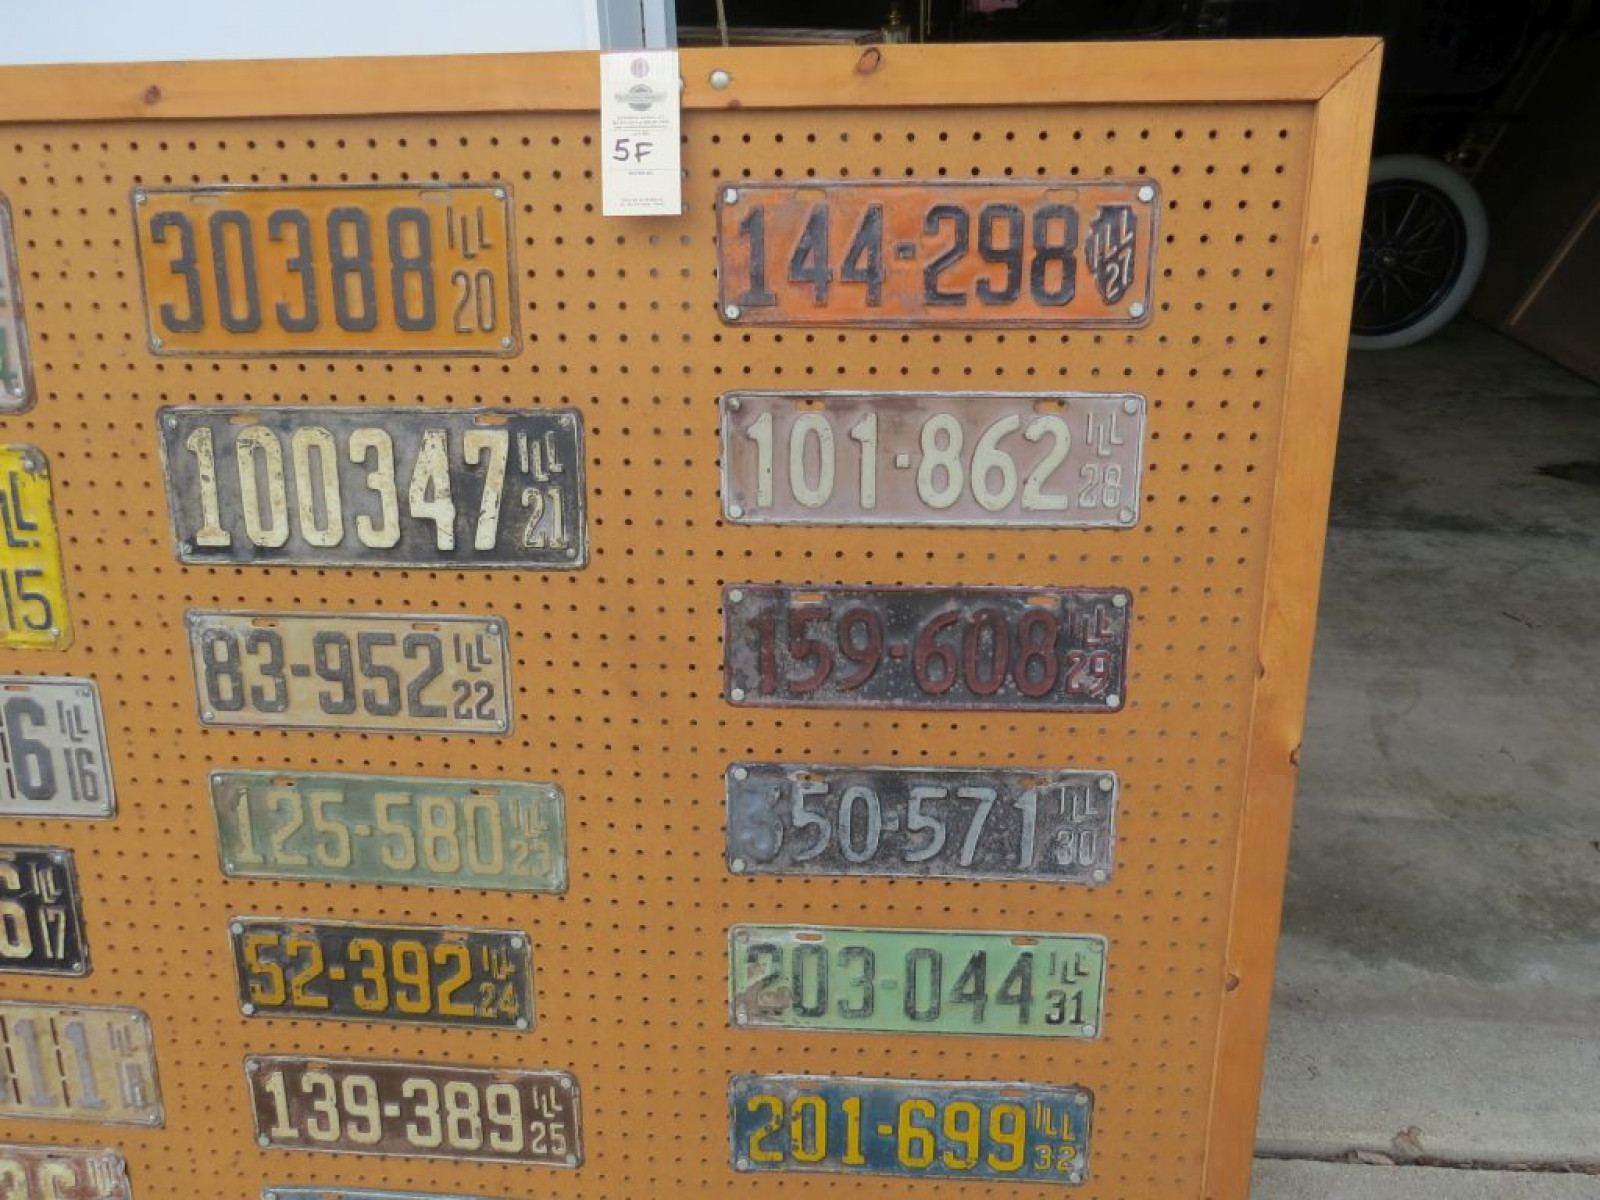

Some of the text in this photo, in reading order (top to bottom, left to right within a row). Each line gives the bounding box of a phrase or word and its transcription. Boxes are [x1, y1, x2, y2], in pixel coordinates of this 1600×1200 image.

[446, 205, 492, 259] ILL
[739, 204, 1078, 306] 144-298
[1094, 208, 1134, 270] ILL
[150, 207, 436, 333] 30388
[1106, 246, 1132, 299] 27
[451, 269, 496, 333] 20
[517, 431, 564, 482] ILL
[1086, 412, 1123, 456] ILL
[746, 411, 1071, 512] 101-862
[1078, 463, 1122, 508] 28
[0, 472, 39, 548] LL.
[186, 426, 509, 551] 100347
[521, 488, 568, 549] 21
[0, 569, 53, 631] 15
[202, 628, 447, 718] 83-952
[453, 633, 492, 673] ILL
[747, 606, 1060, 697] 159-608
[1064, 649, 1112, 697] 29
[56, 700, 88, 742] ILL
[452, 679, 496, 720] 22
[64, 747, 99, 802] 16
[1058, 786, 1098, 822] ILL
[233, 787, 503, 875] 125-580
[1055, 829, 1097, 866] 30
[39, 907, 66, 960] 17
[243, 932, 475, 1017] 52-392
[745, 943, 1034, 1025] 203-044
[1048, 951, 1089, 985] ILL
[480, 983, 521, 1018] 24
[1044, 988, 1085, 1025] 31
[264, 1071, 525, 1153] 139-389
[532, 1086, 562, 1118] ILL
[1035, 1102, 1077, 1142] ILL
[530, 1122, 566, 1155] 25
[747, 1094, 1026, 1172] 201-699
[1034, 1144, 1076, 1172] 32
